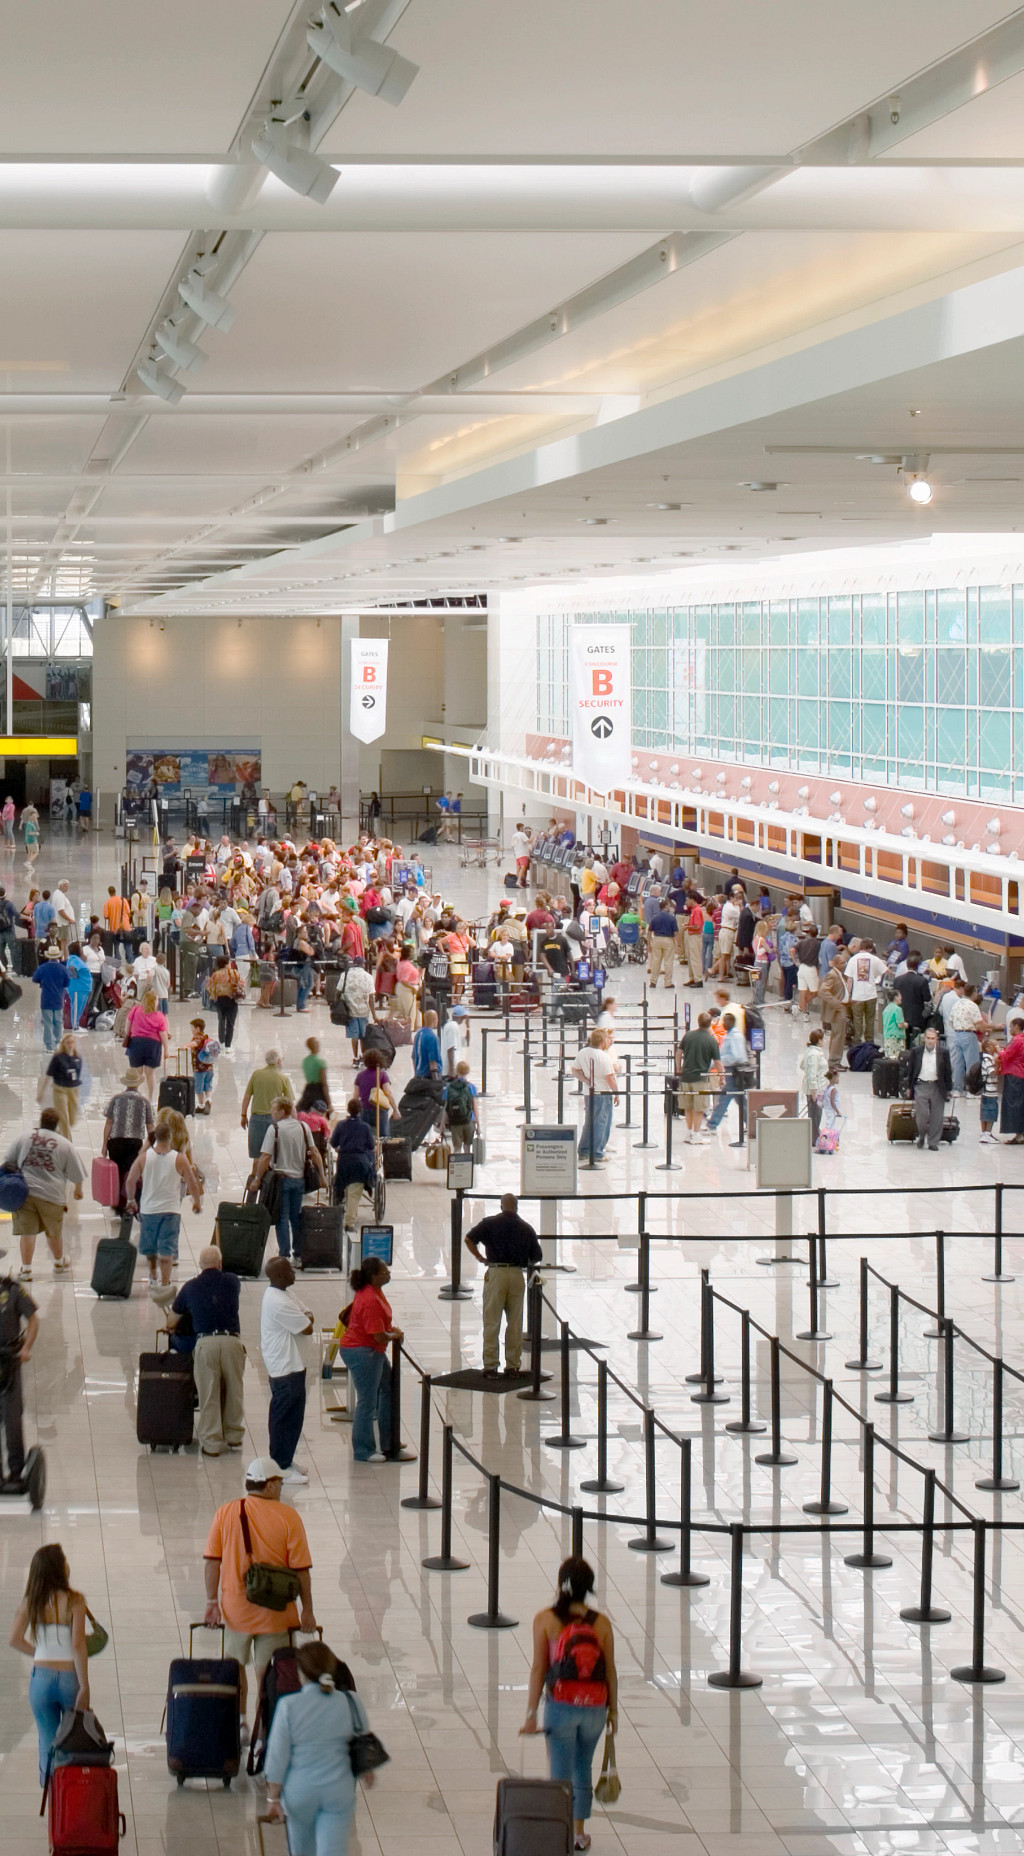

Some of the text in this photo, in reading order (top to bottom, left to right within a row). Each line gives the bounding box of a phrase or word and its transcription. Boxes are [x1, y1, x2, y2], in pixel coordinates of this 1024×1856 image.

[587, 645, 616, 654] GATES
[363, 666, 377, 683] B
[592, 669, 613, 696] B
[579, 699, 624, 708] SECURITY
